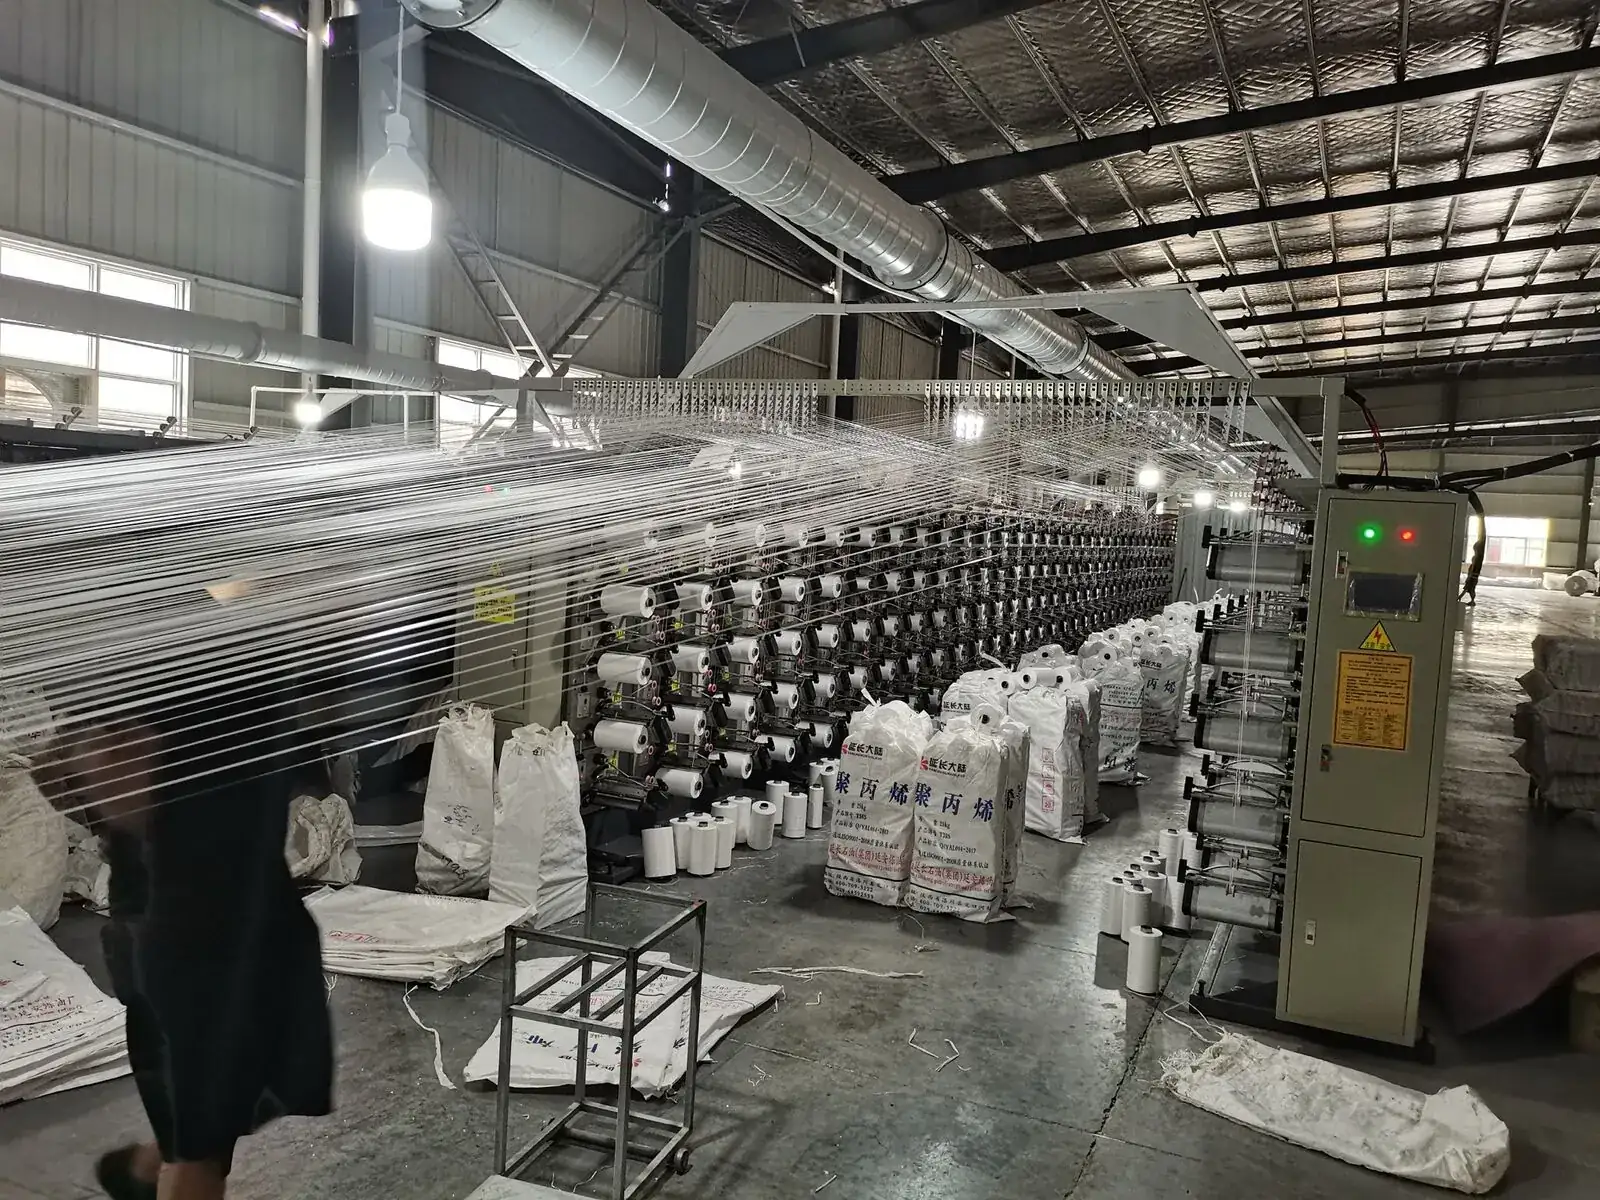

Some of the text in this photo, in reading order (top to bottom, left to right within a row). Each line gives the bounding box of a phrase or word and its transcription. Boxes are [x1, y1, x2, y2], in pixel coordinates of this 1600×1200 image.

[835, 770, 909, 806] 聚丙烯
[914, 782, 994, 822] 聚丙烯
